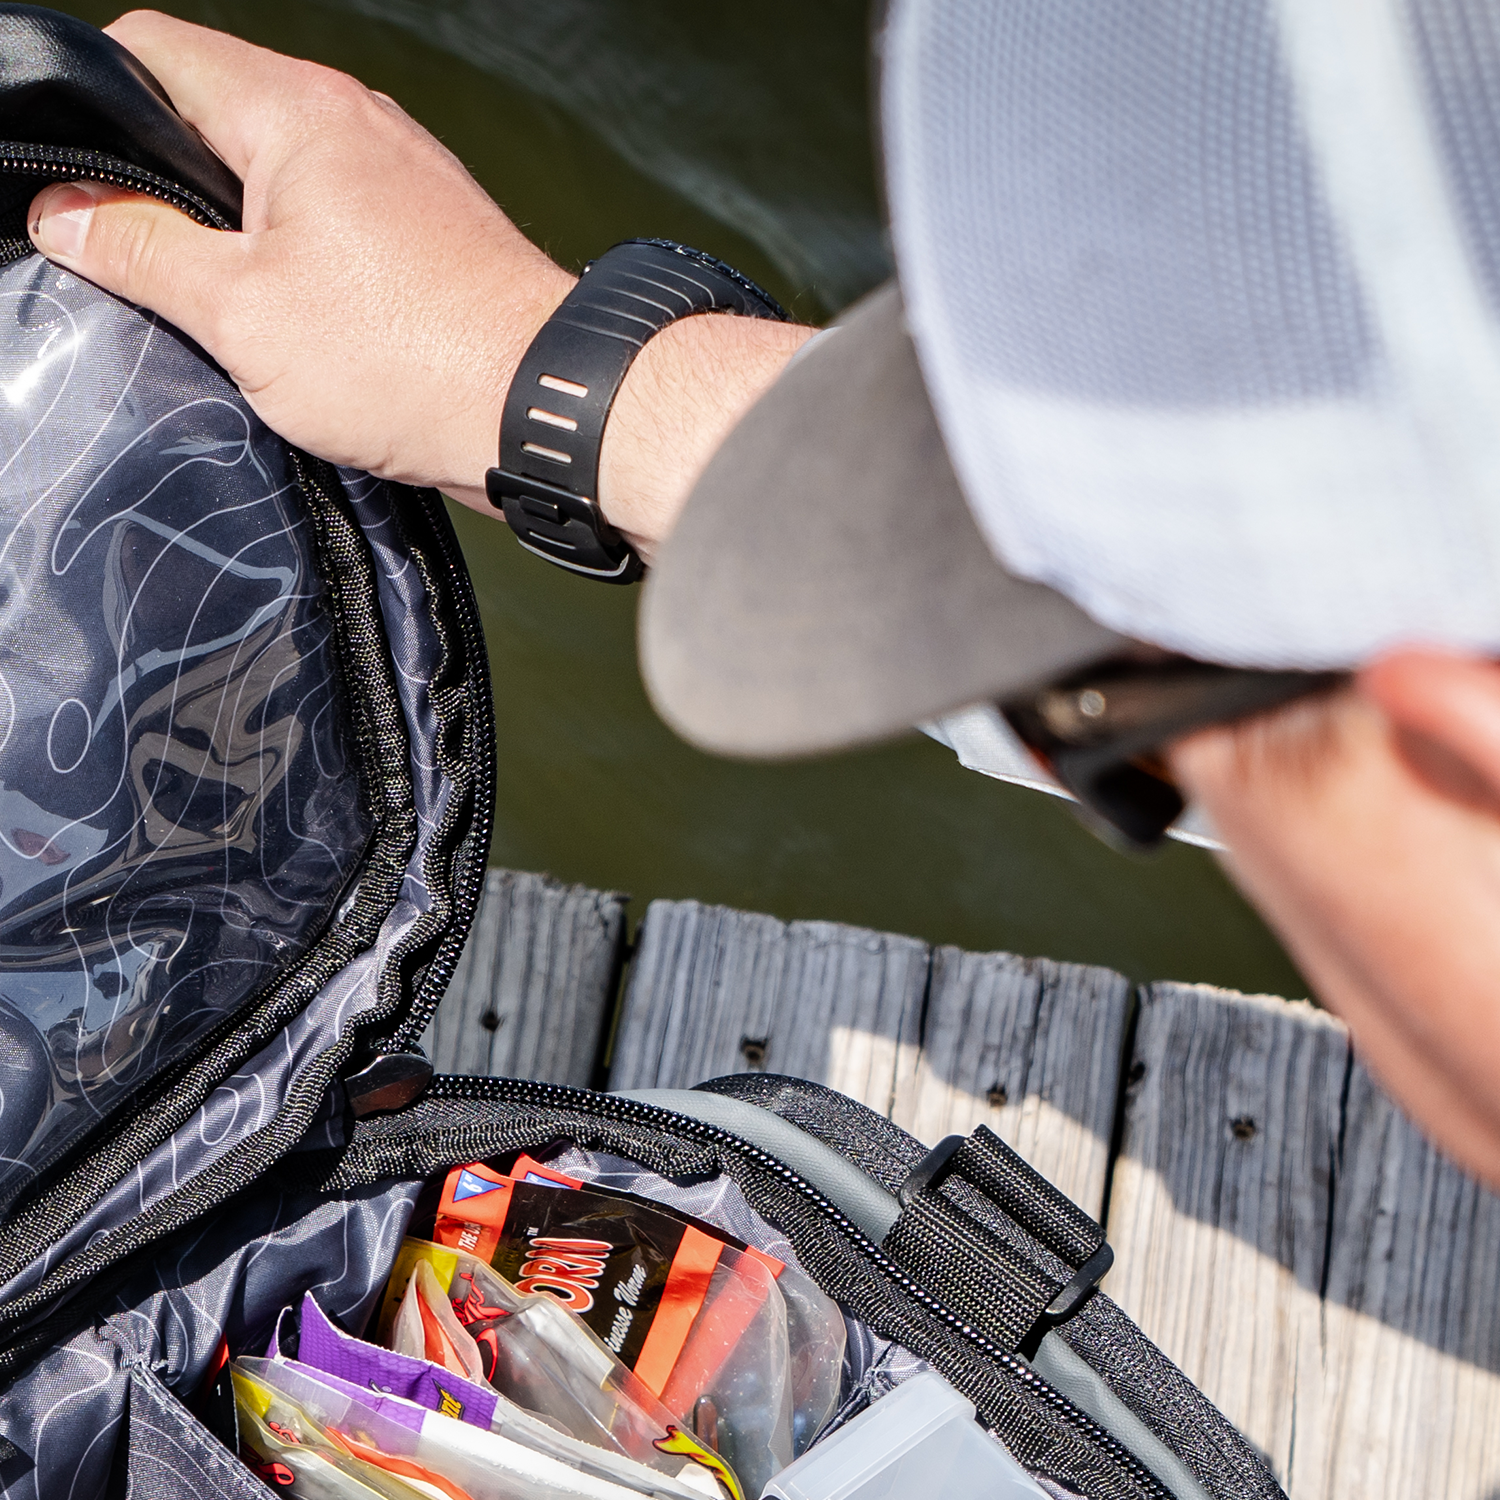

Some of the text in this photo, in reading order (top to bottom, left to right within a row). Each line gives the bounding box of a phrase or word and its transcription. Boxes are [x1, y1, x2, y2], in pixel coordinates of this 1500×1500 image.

[458, 1230, 478, 1250] THE
[604, 1264, 646, 1352] inesse Worm
